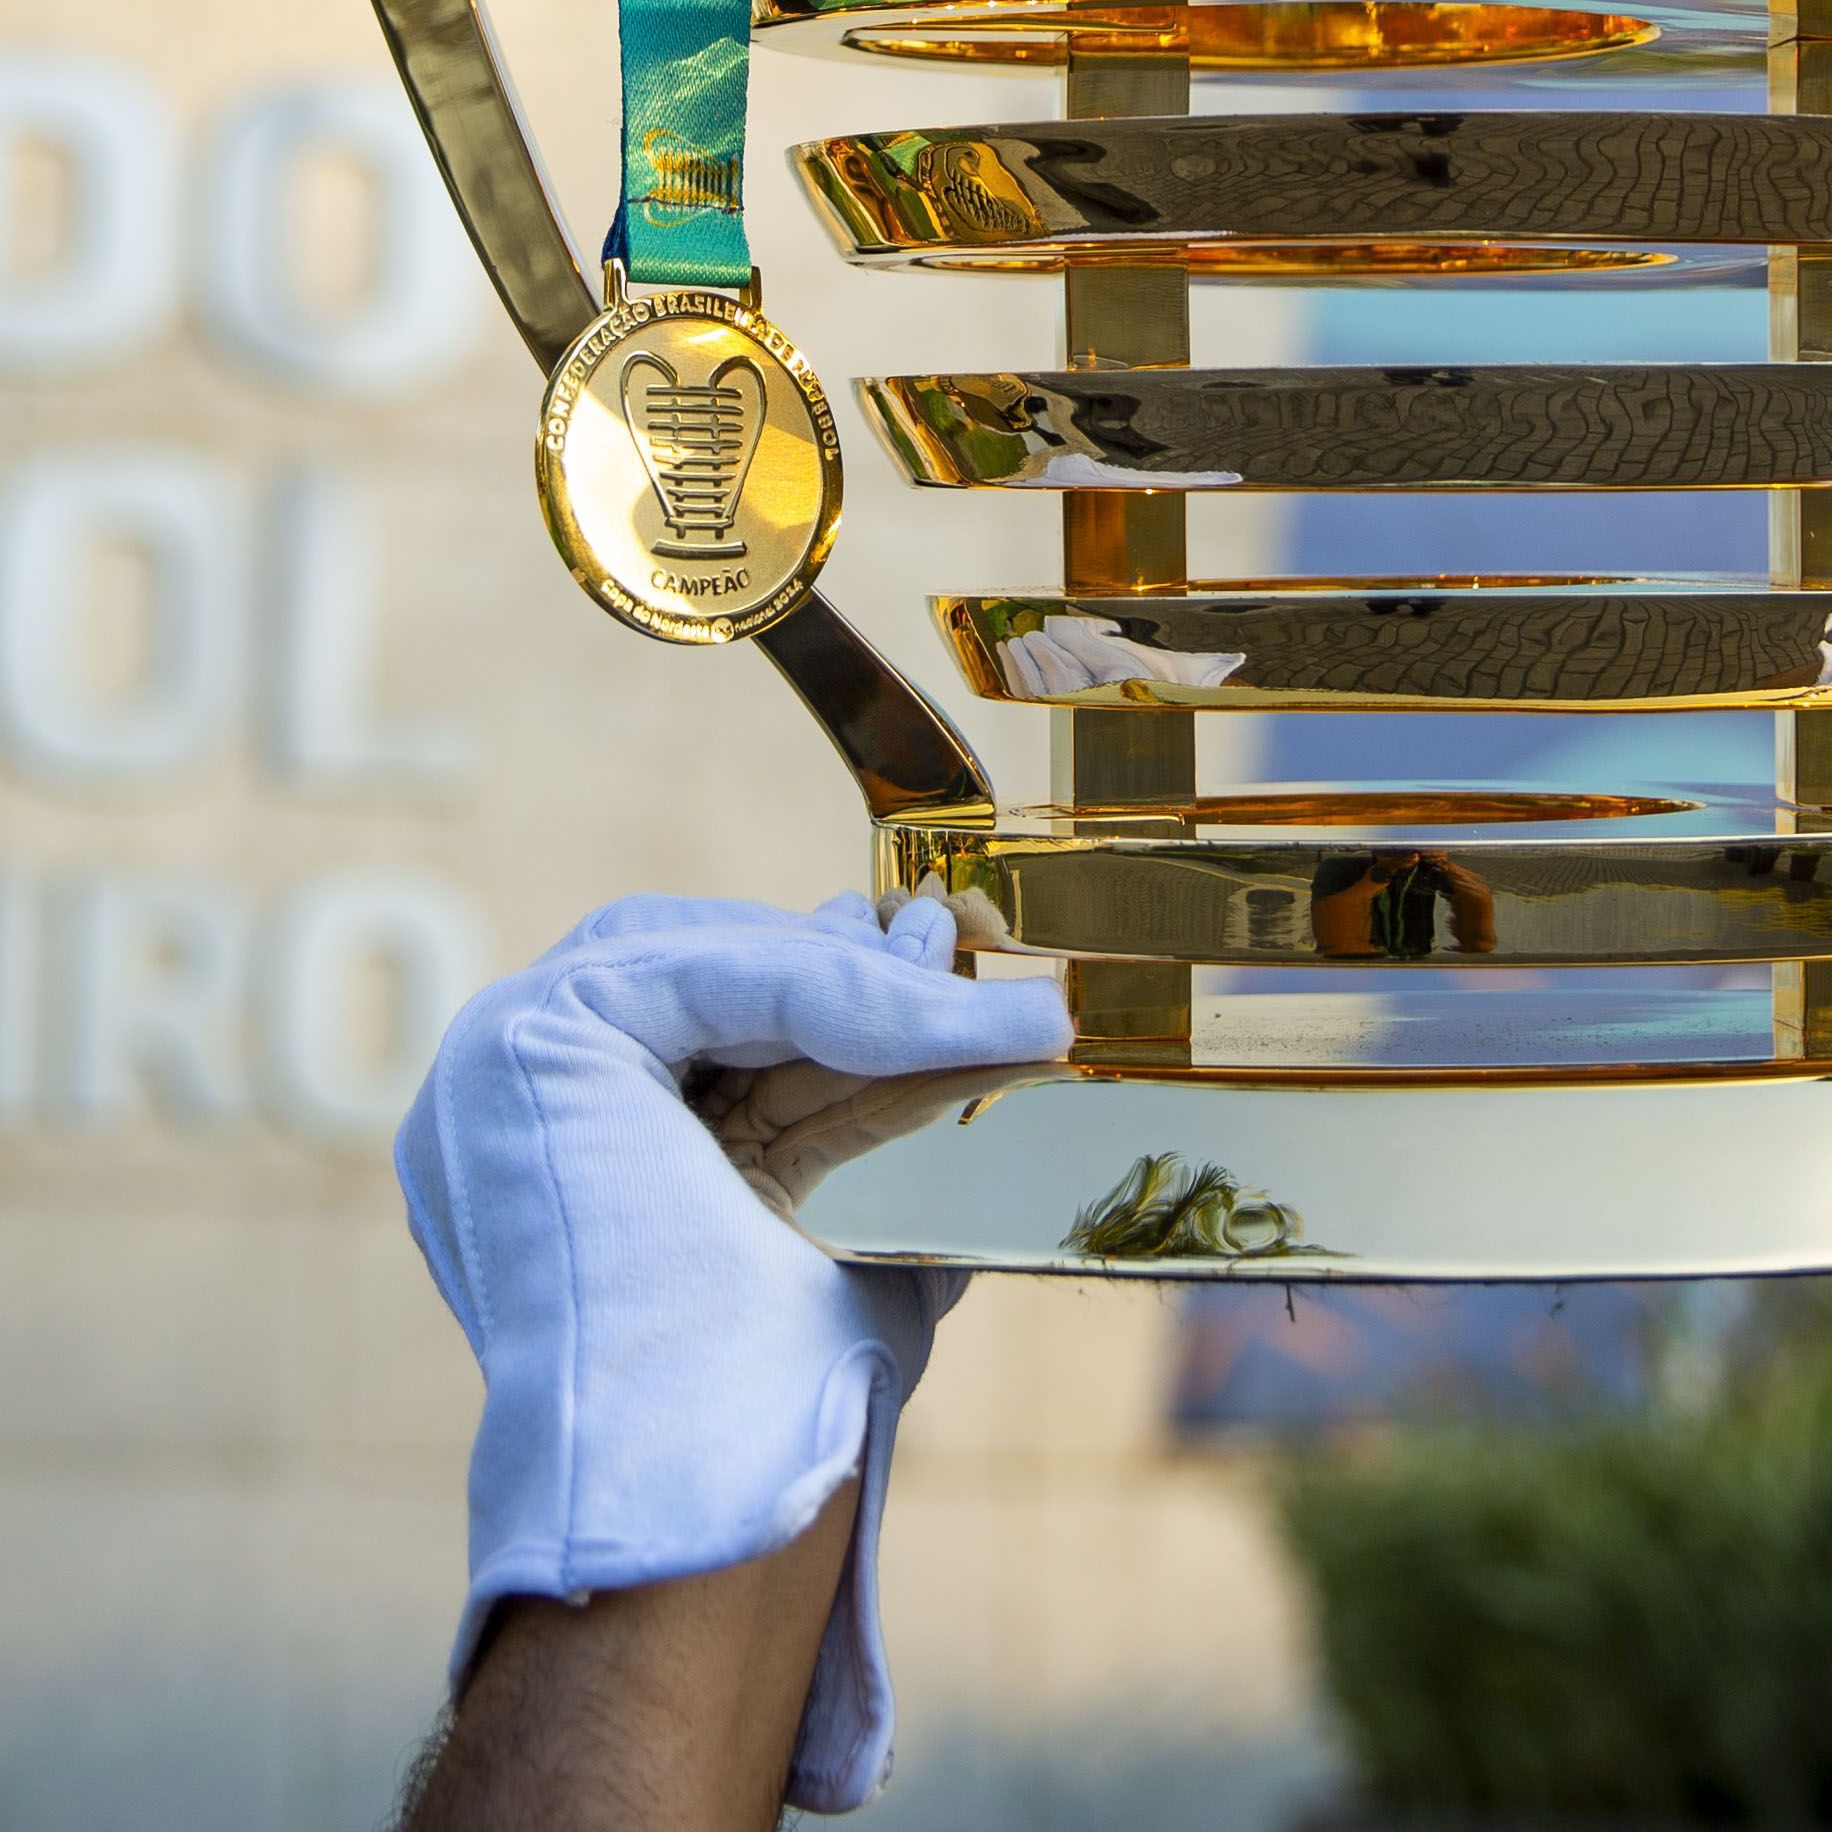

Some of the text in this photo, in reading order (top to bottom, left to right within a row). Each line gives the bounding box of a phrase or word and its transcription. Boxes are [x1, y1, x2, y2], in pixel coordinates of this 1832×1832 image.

[547, 303, 651, 450] CONFEDERAÇÃO
[654, 293, 770, 342] BRASILEIRA
[650, 567, 752, 597] CAMPEÃO
